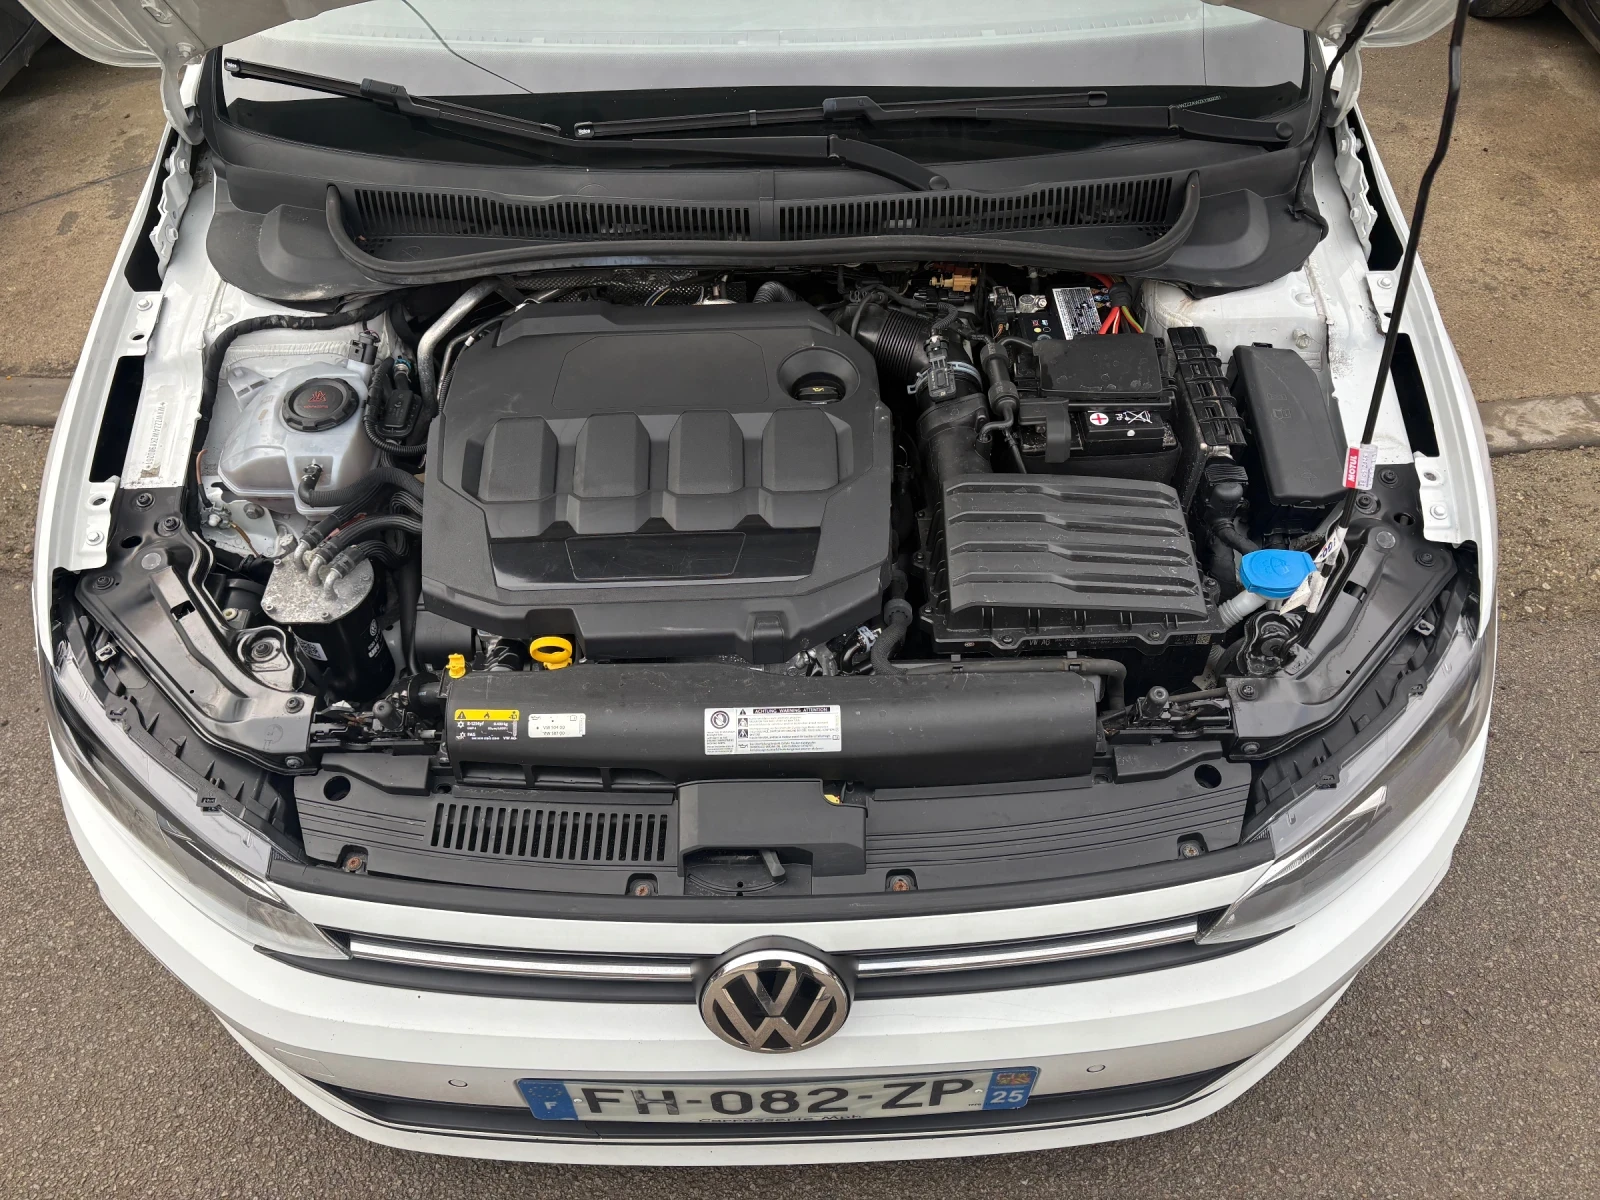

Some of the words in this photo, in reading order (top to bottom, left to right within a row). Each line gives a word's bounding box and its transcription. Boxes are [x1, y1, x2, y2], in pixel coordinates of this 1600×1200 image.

[1347, 455, 1358, 482] MOTUL
[706, 960, 843, 1052] VW
[544, 1101, 557, 1113] F
[581, 1079, 974, 1115] FH-082-ZP
[989, 1089, 1025, 1104] 25
